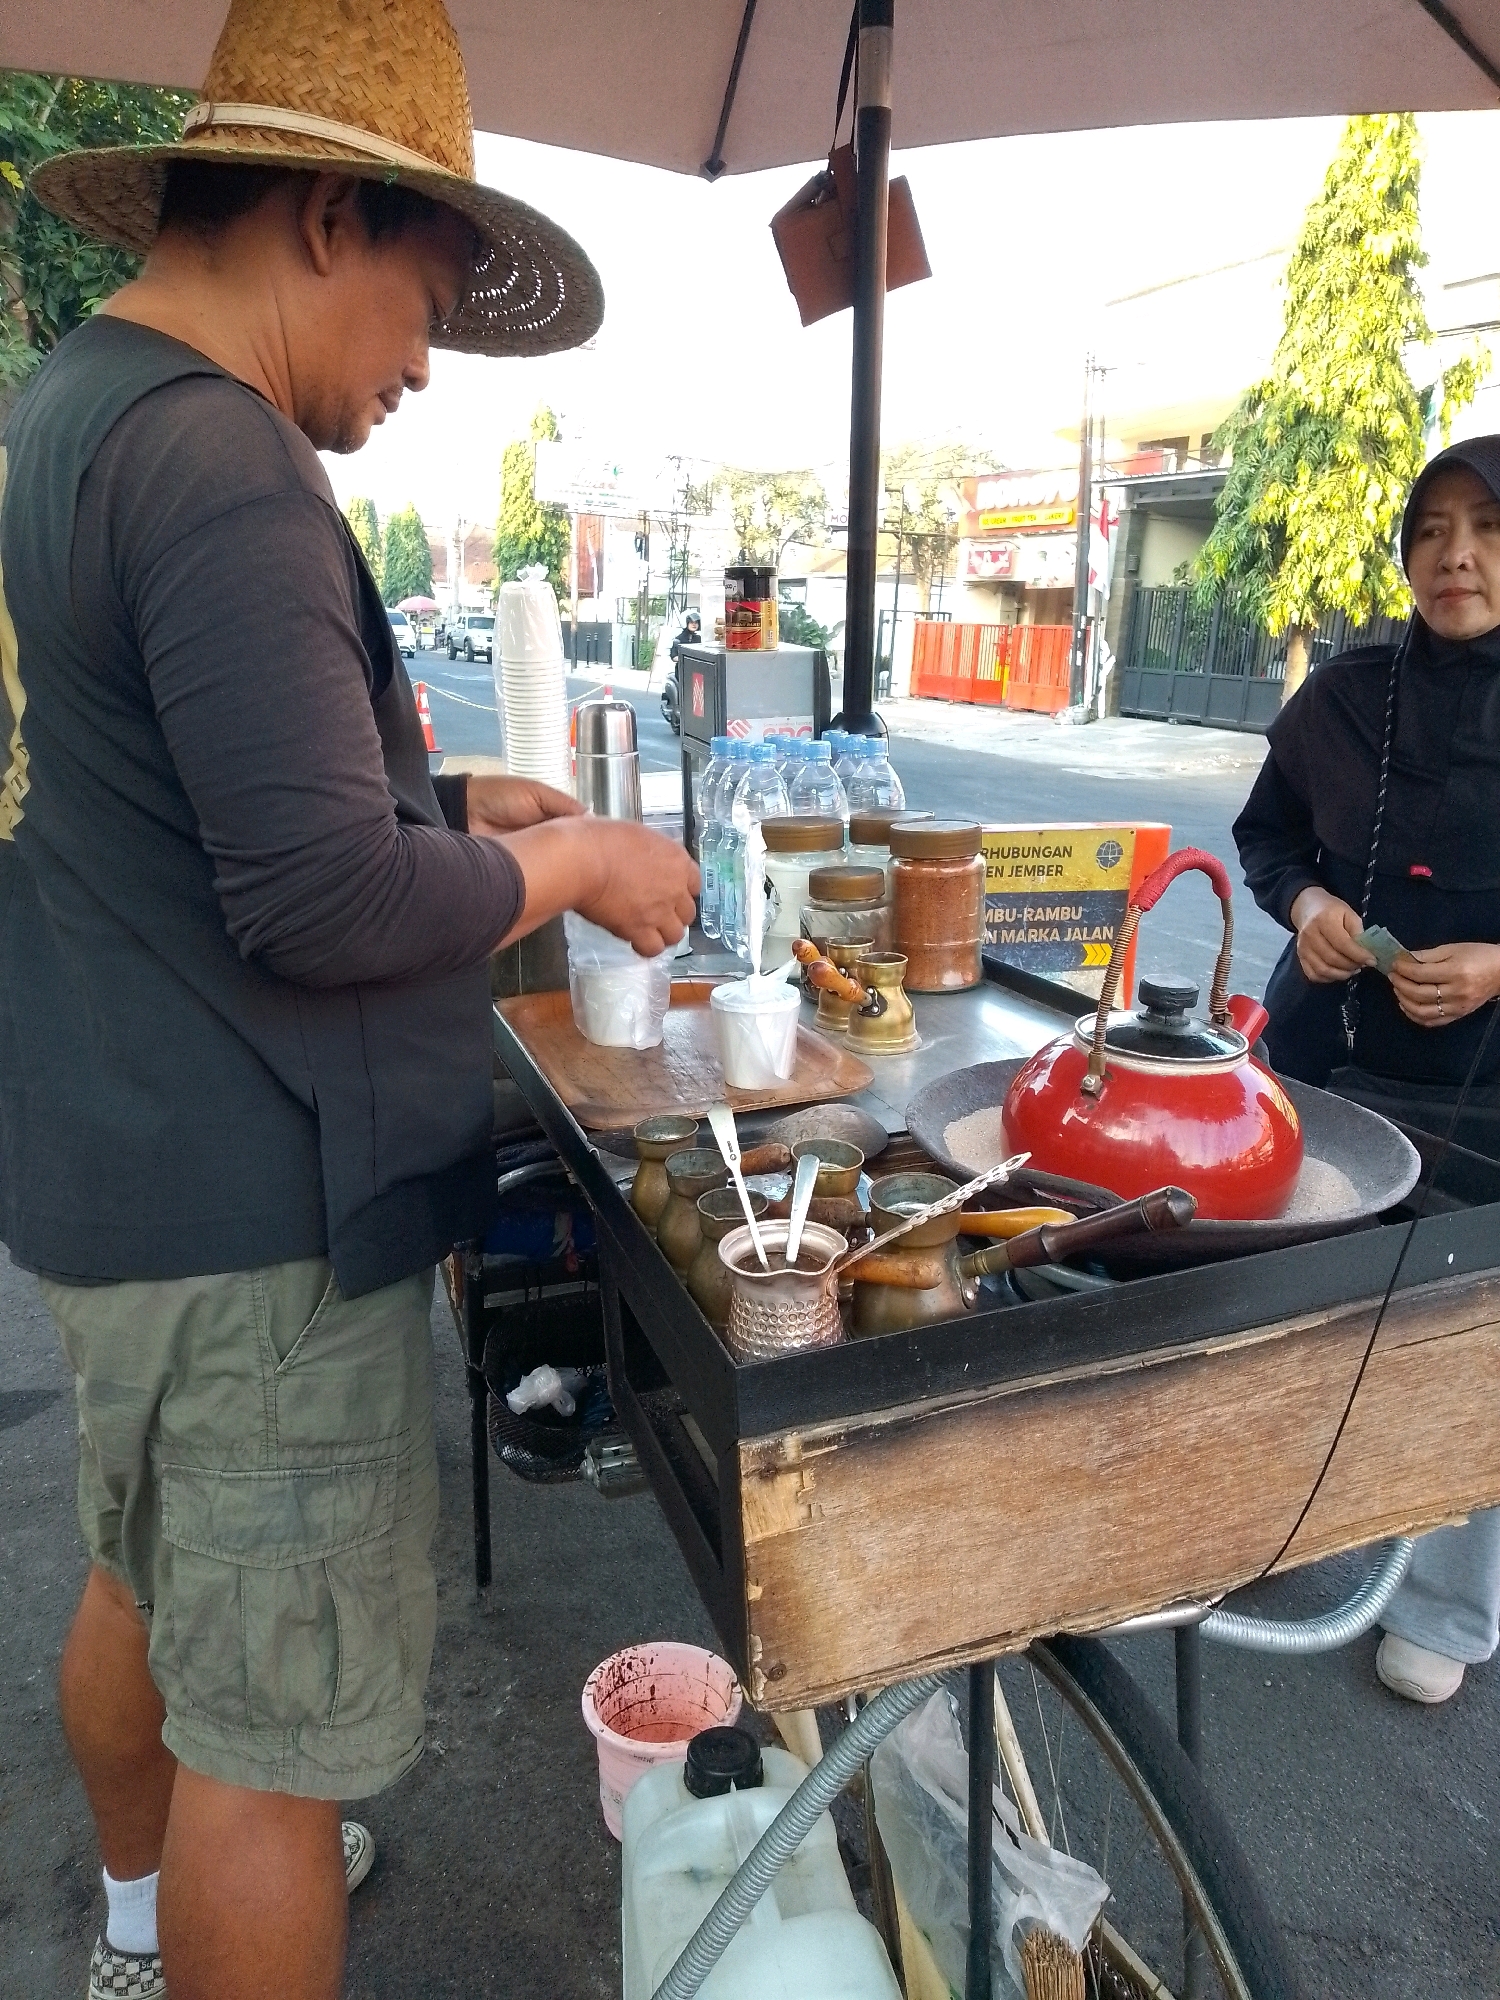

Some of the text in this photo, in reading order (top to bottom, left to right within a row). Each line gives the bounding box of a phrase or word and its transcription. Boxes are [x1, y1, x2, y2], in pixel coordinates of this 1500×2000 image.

[1007, 864, 1064, 878] JEMBER
[1000, 927, 1061, 944] MARKA
[1063, 925, 1114, 941] JALAN
